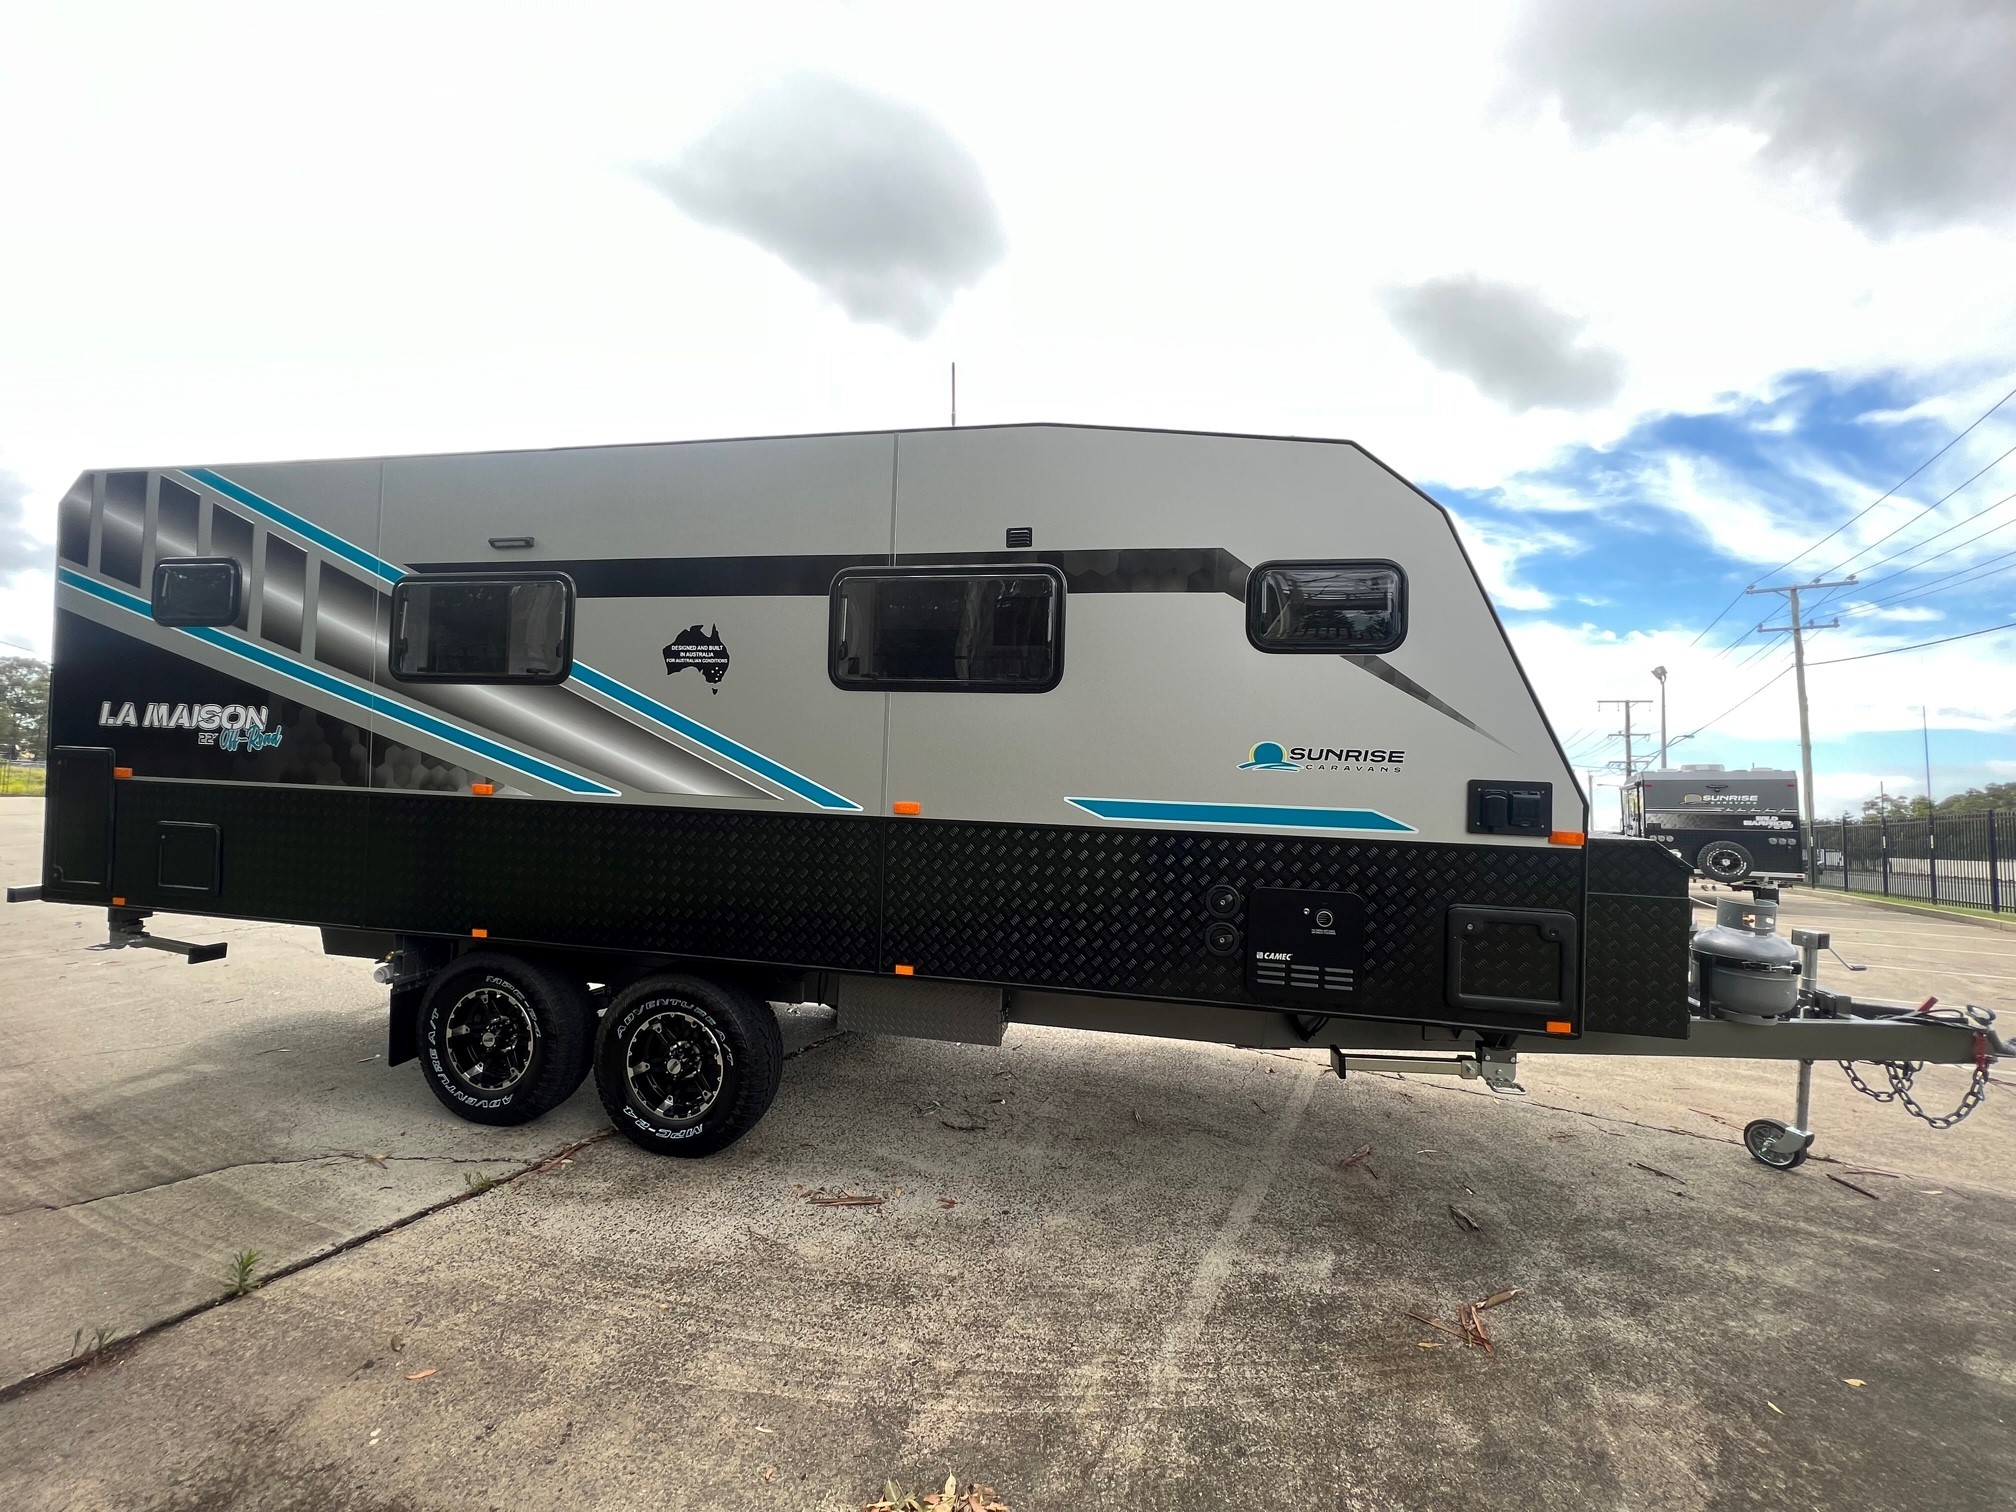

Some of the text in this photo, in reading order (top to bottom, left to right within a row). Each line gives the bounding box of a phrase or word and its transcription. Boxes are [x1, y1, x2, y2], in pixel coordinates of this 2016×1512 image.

[99, 701, 269, 730] LA MAISON
[219, 725, 282, 752] Off-Road
[1289, 747, 1406, 763] SUNRISE
[1305, 764, 1402, 773] CARAVANS
[1264, 952, 1292, 961] CAMEC
[617, 998, 717, 1040] ADVENTURE
[429, 1047, 513, 1108] ADVENTURE
